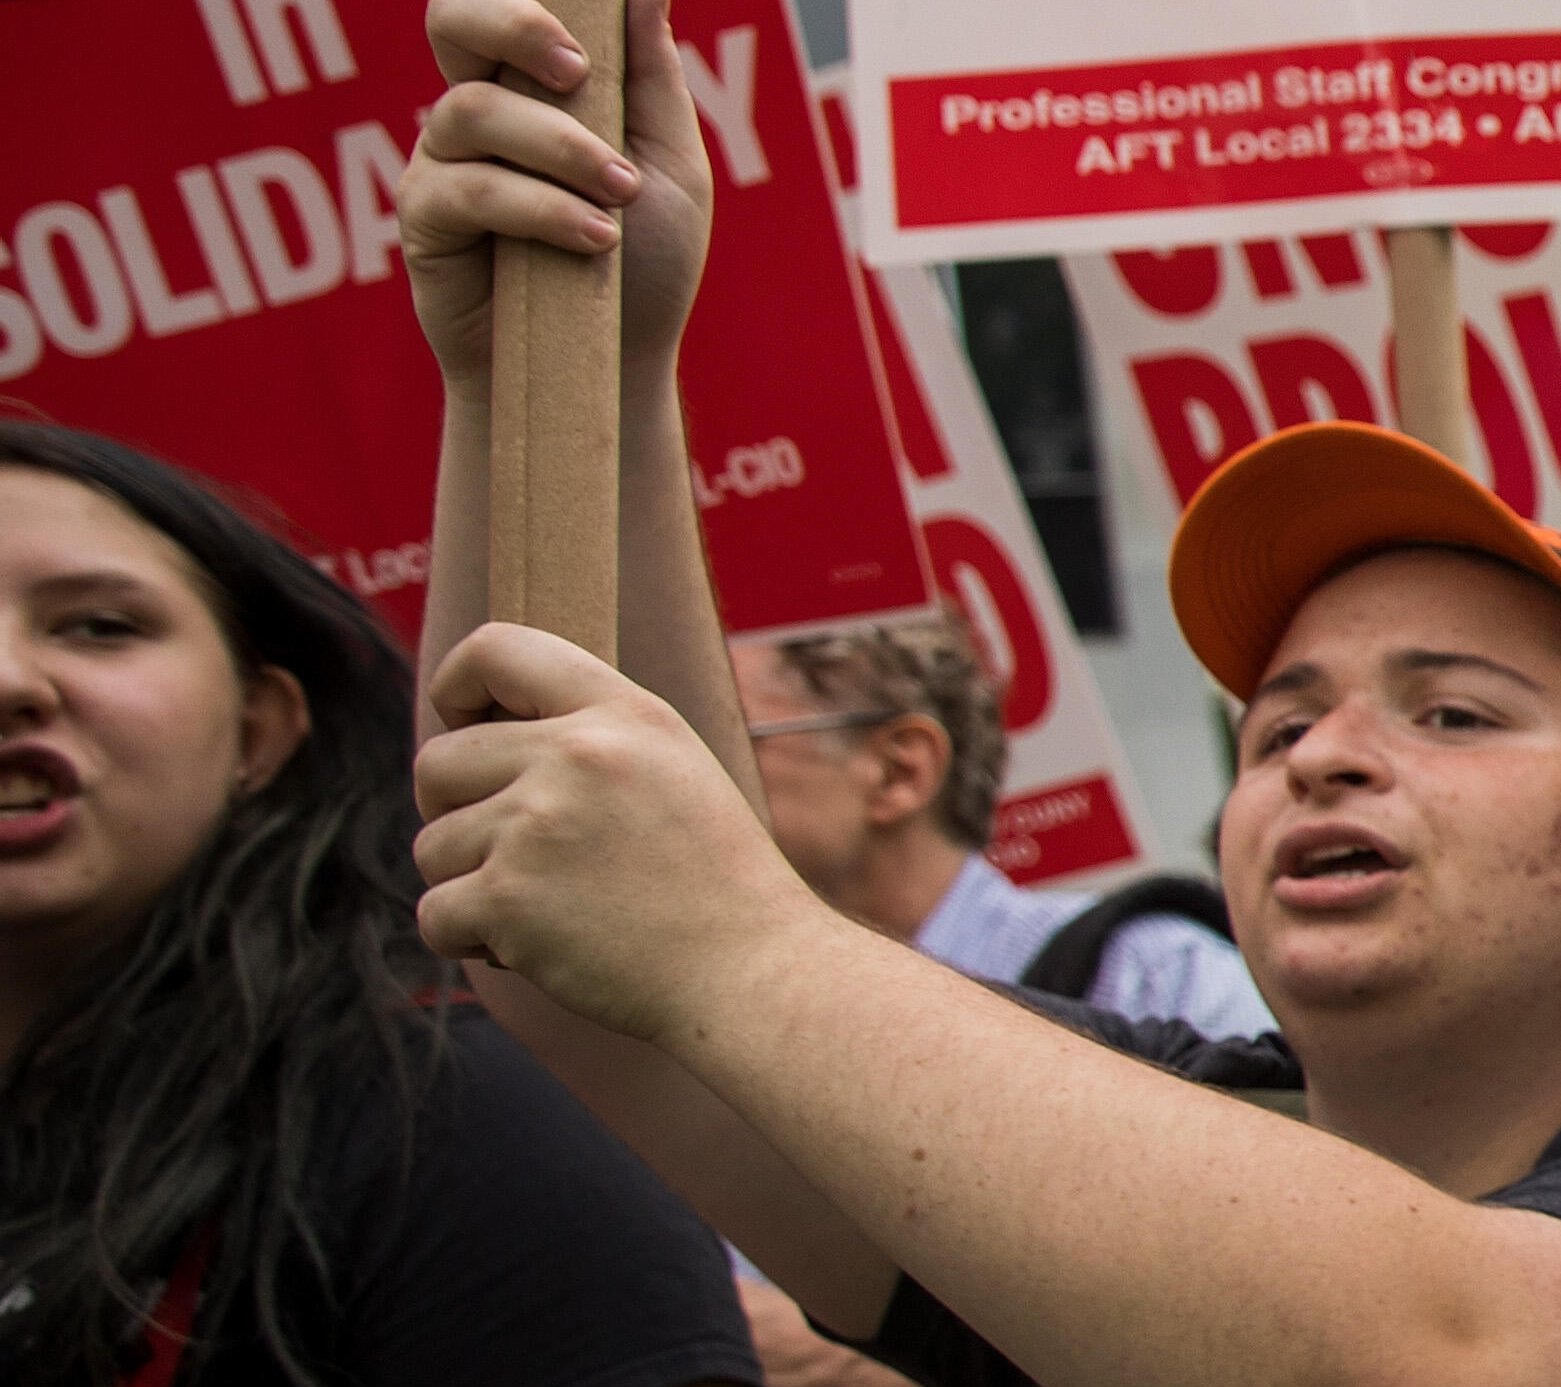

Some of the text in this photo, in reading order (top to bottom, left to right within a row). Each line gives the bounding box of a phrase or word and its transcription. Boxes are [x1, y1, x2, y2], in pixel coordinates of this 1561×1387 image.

[941, 69, 1261, 135] Professional
[1275, 56, 1393, 108] Staff
[1076, 129, 1181, 176] AFT
[1197, 118, 1330, 168] Local
[1340, 106, 1464, 154] 2334
